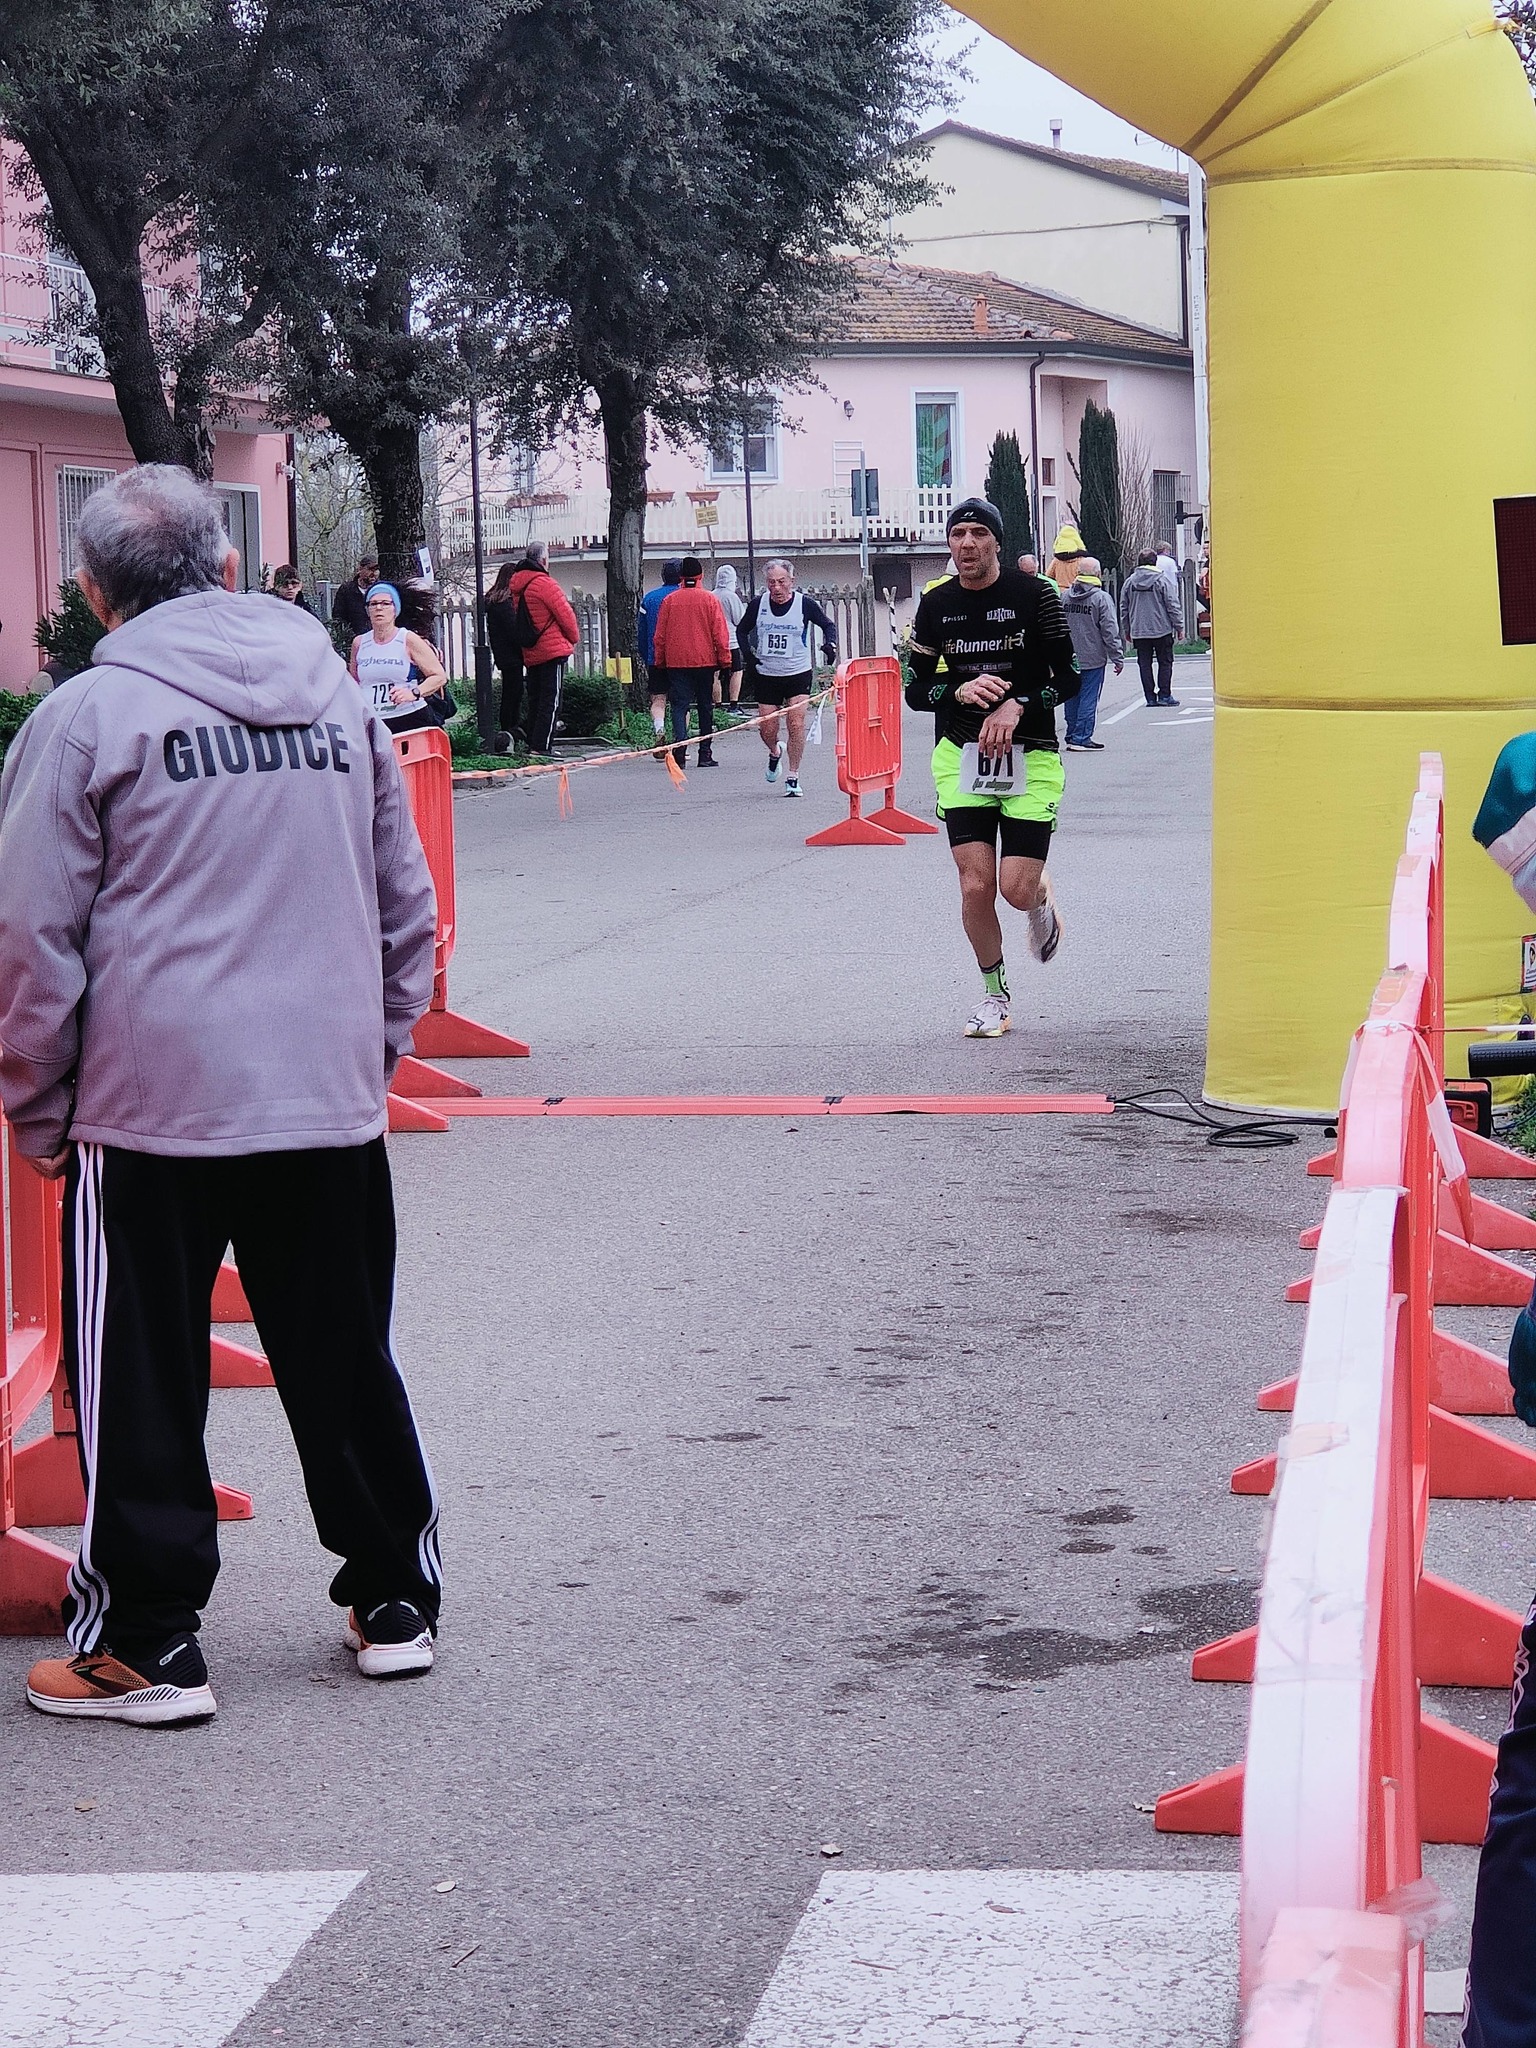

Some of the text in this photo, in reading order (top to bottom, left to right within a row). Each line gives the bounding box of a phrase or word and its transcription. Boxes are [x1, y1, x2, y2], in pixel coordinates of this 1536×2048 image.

[1063, 603, 1092, 616] GIUDICE
[768, 634, 787, 649] 635
[163, 722, 350, 783] GIUDICE
